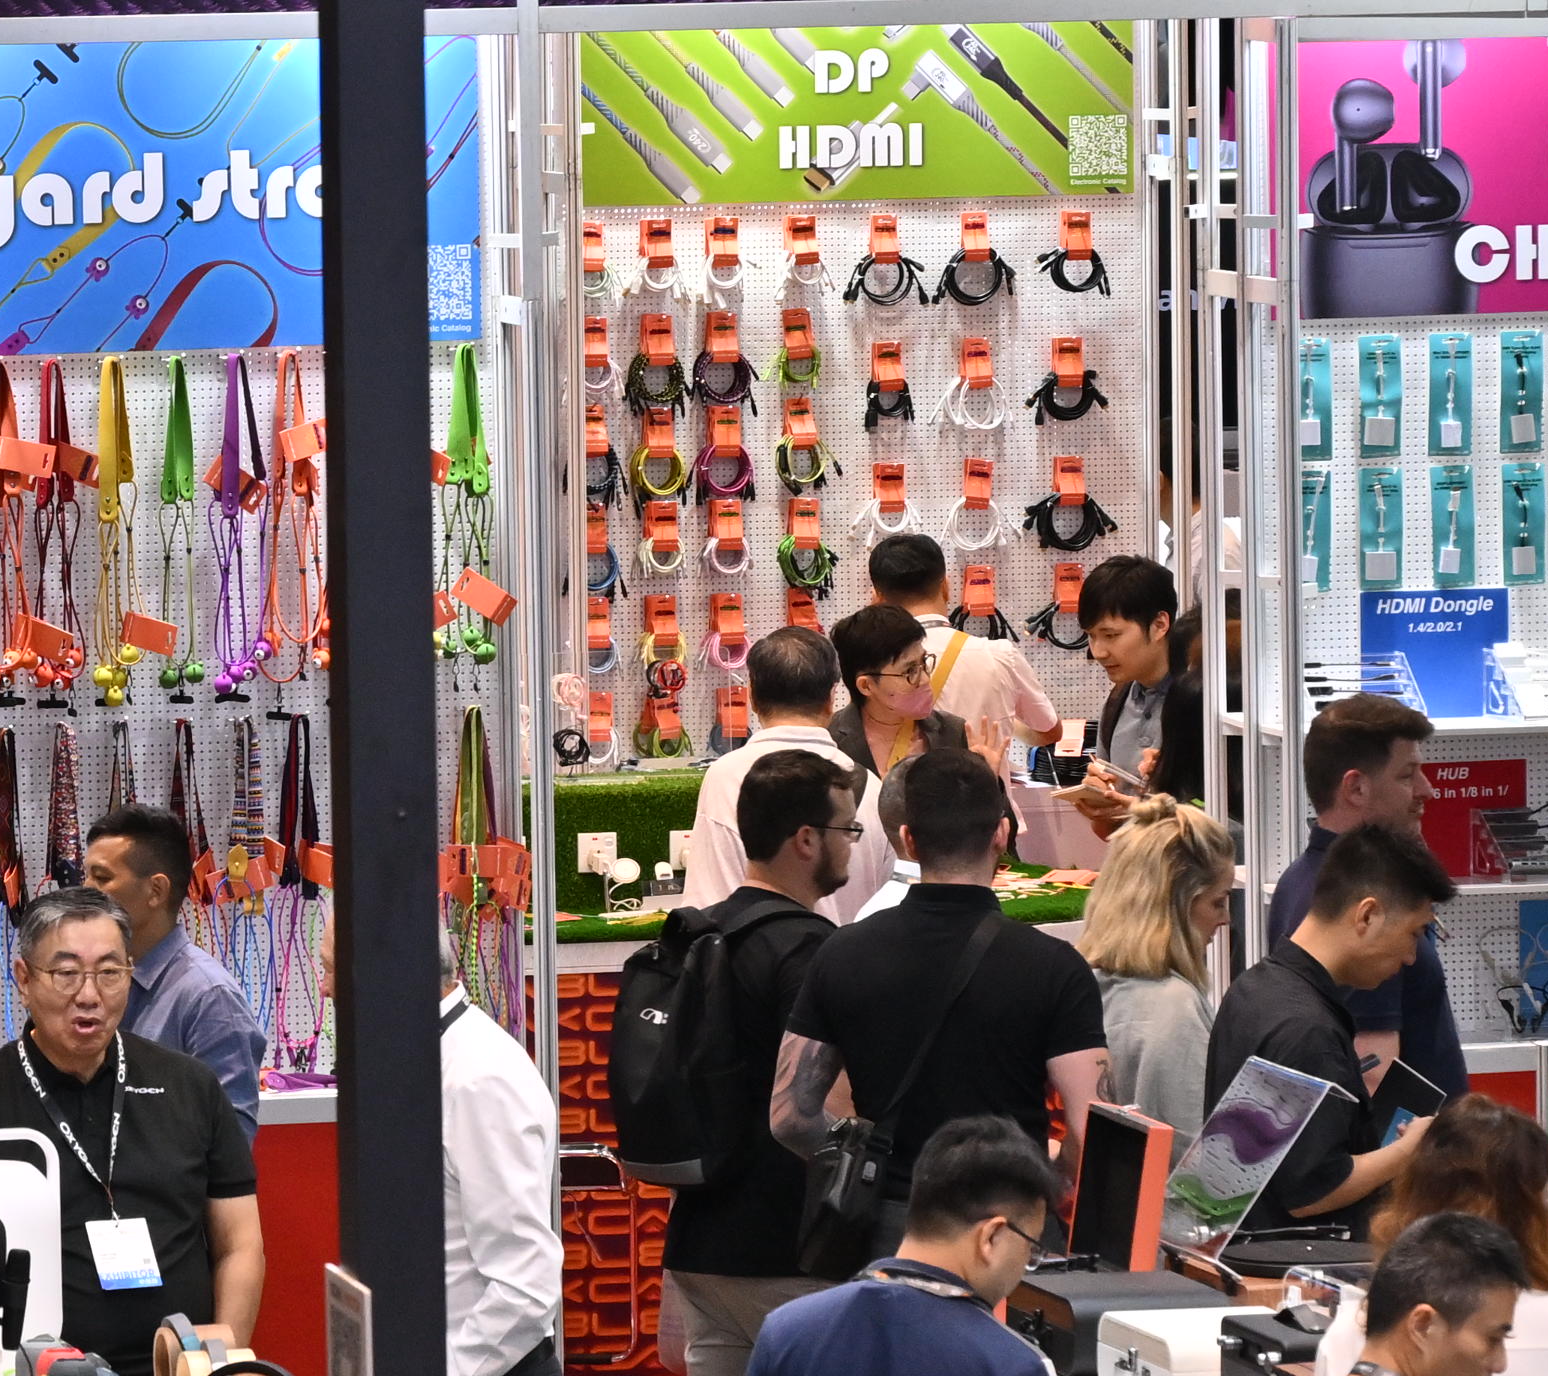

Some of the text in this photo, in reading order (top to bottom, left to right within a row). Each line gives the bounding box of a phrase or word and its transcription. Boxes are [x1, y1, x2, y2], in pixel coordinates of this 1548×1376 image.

[814, 47, 890, 94] DP
[778, 122, 924, 171] HDMI
[441, 324, 472, 332] Catalog
[1376, 595, 1494, 617] HDMI Dongle
[1437, 766, 1470, 780] HUB
